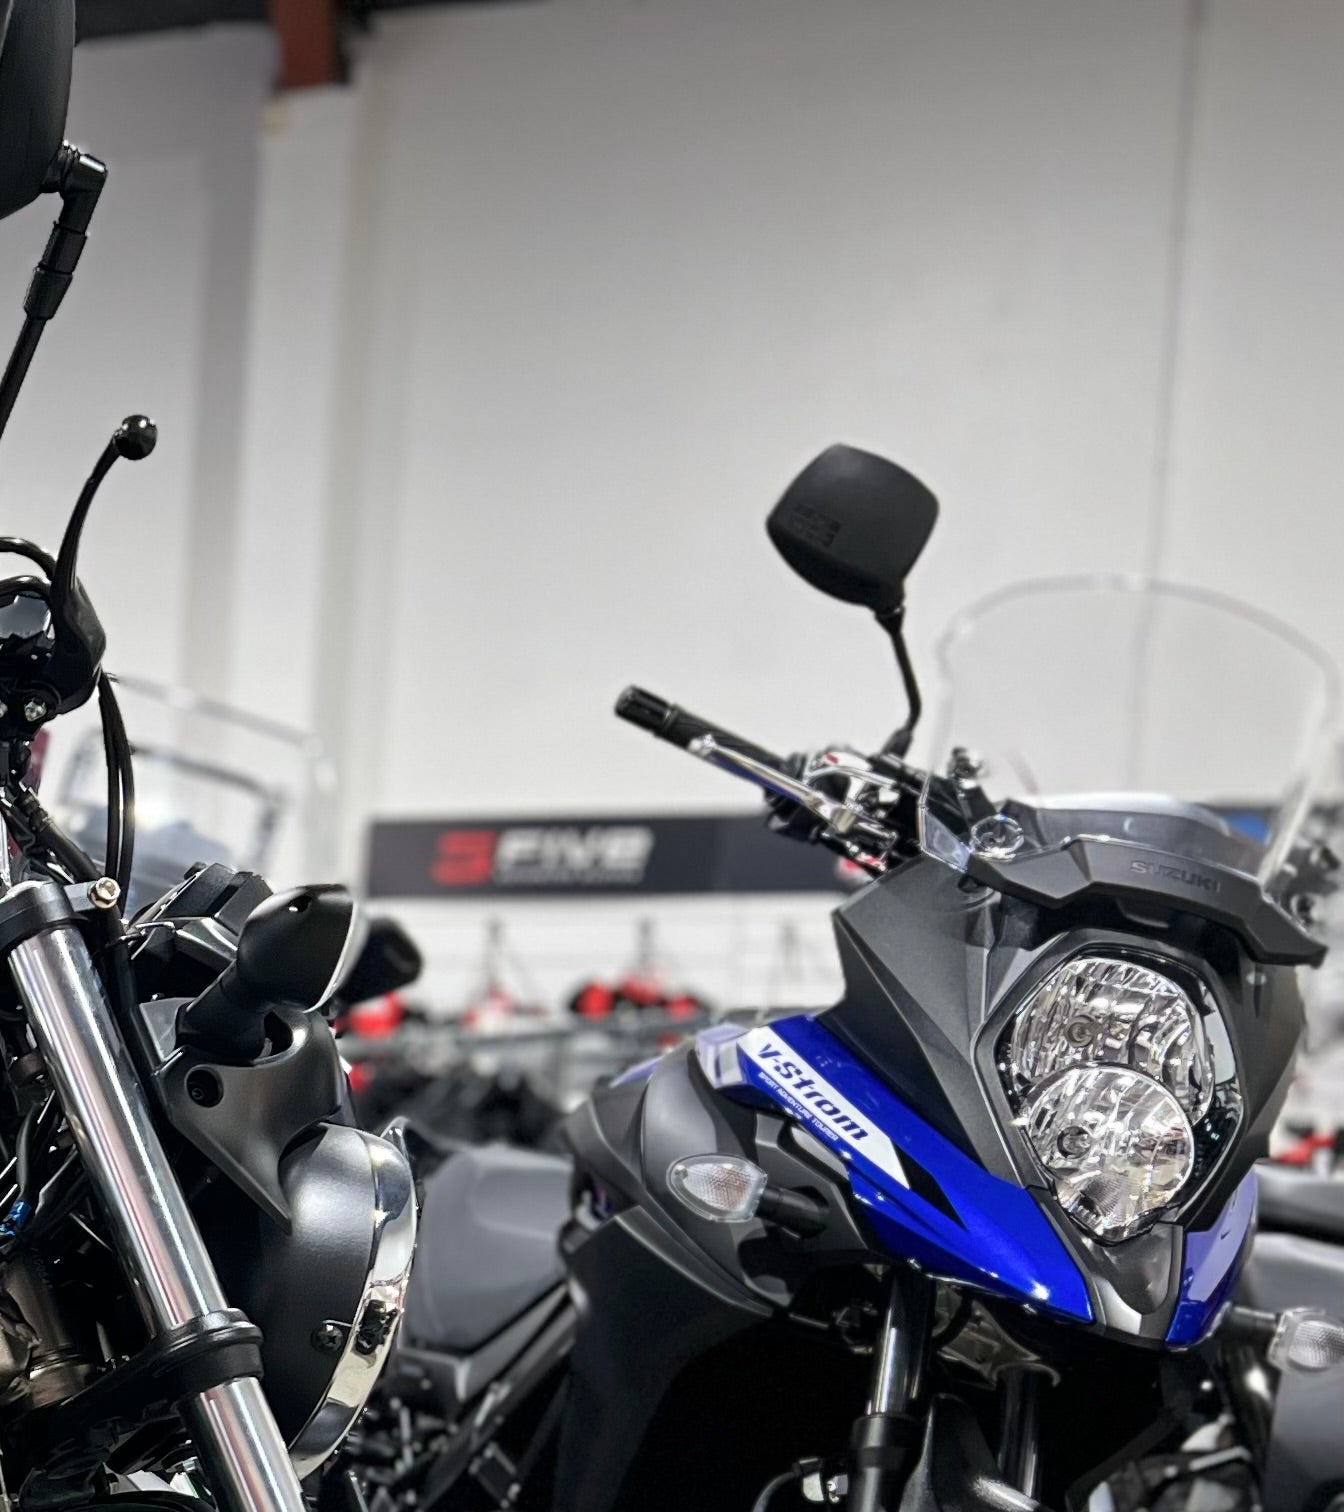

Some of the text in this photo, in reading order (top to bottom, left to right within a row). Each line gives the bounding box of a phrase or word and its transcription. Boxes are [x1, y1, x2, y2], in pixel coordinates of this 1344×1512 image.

[1130, 861, 1222, 894] SUZUKI
[758, 1043, 868, 1141] V-Strom
[758, 1072, 839, 1141] SPORT ADVENTURE TOURER
